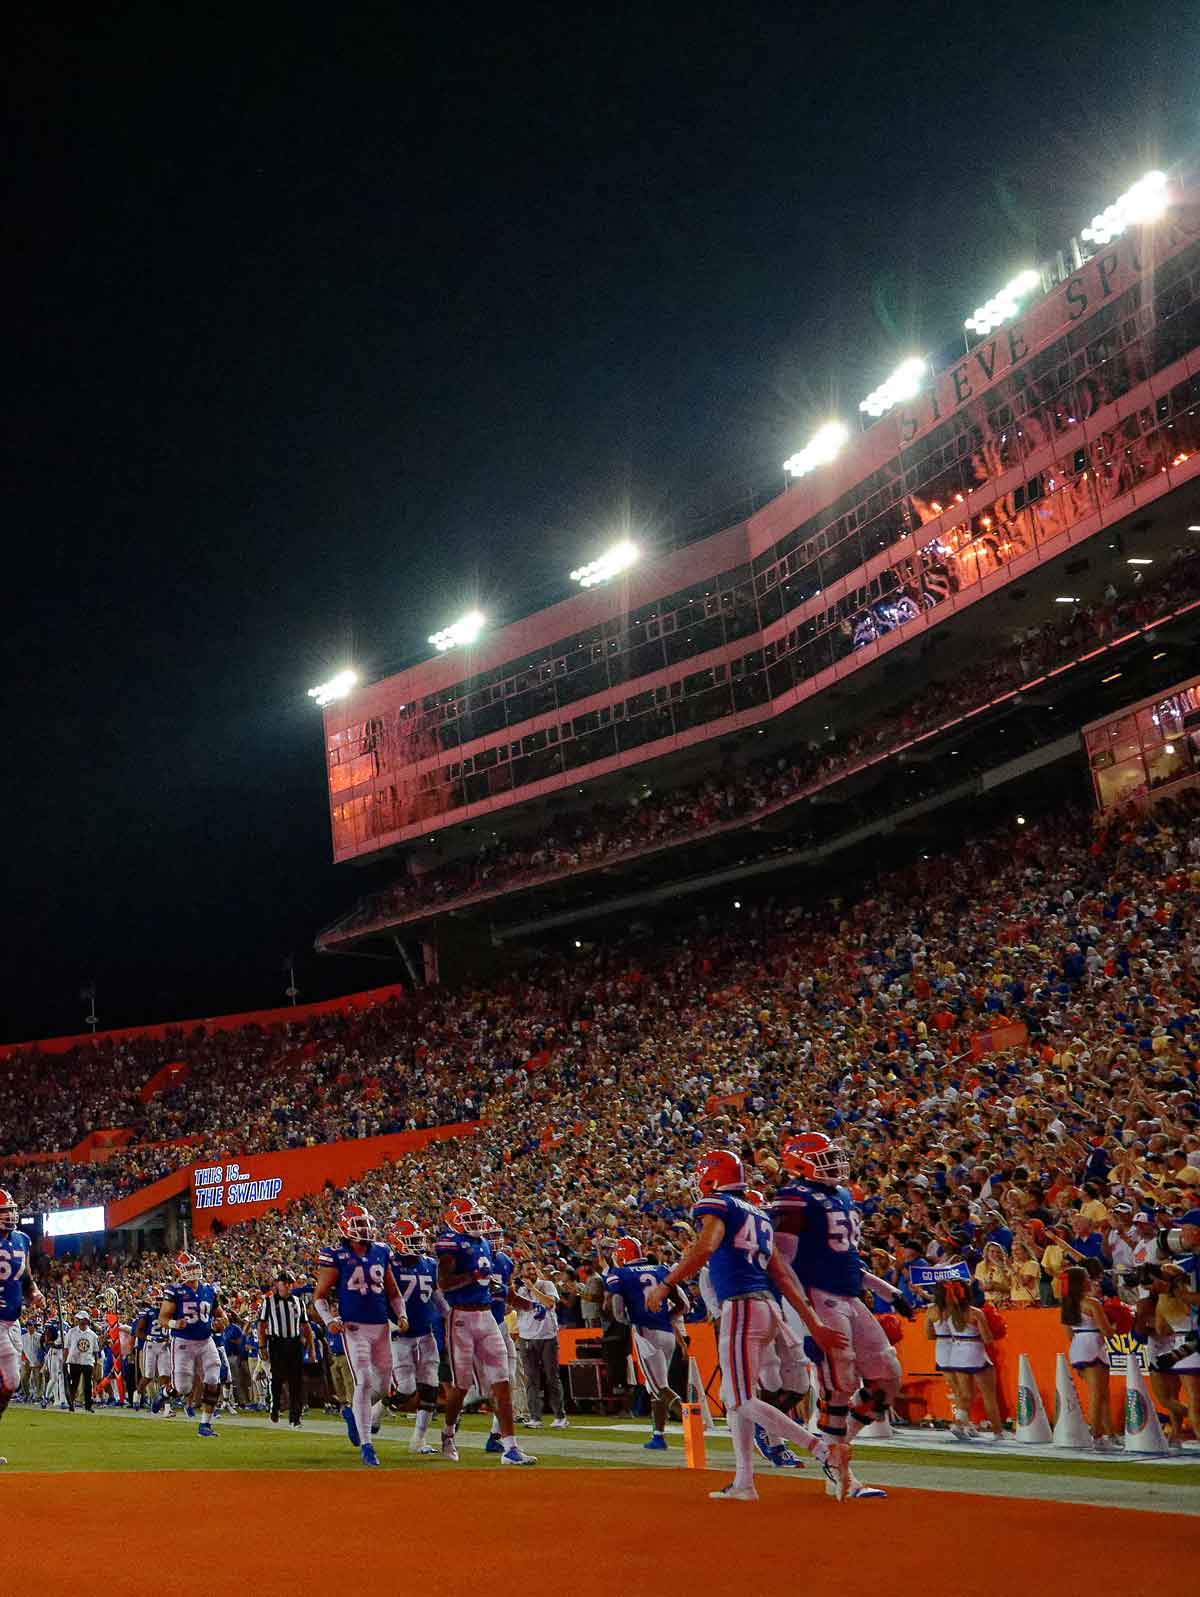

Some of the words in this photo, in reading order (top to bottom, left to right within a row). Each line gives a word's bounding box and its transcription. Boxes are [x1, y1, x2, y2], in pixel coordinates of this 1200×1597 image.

[901, 329, 1029, 441] STEVE
[194, 1166, 223, 1187] THIS
[226, 1164, 251, 1182] IS...
[195, 1186, 224, 1209] THE
[227, 1178, 283, 1205] SWAMP
[922, 1271, 933, 1281] GO
[934, 1269, 960, 1281] GATORS
[400, 1274, 433, 1303] 75
[182, 1301, 211, 1324] 50
